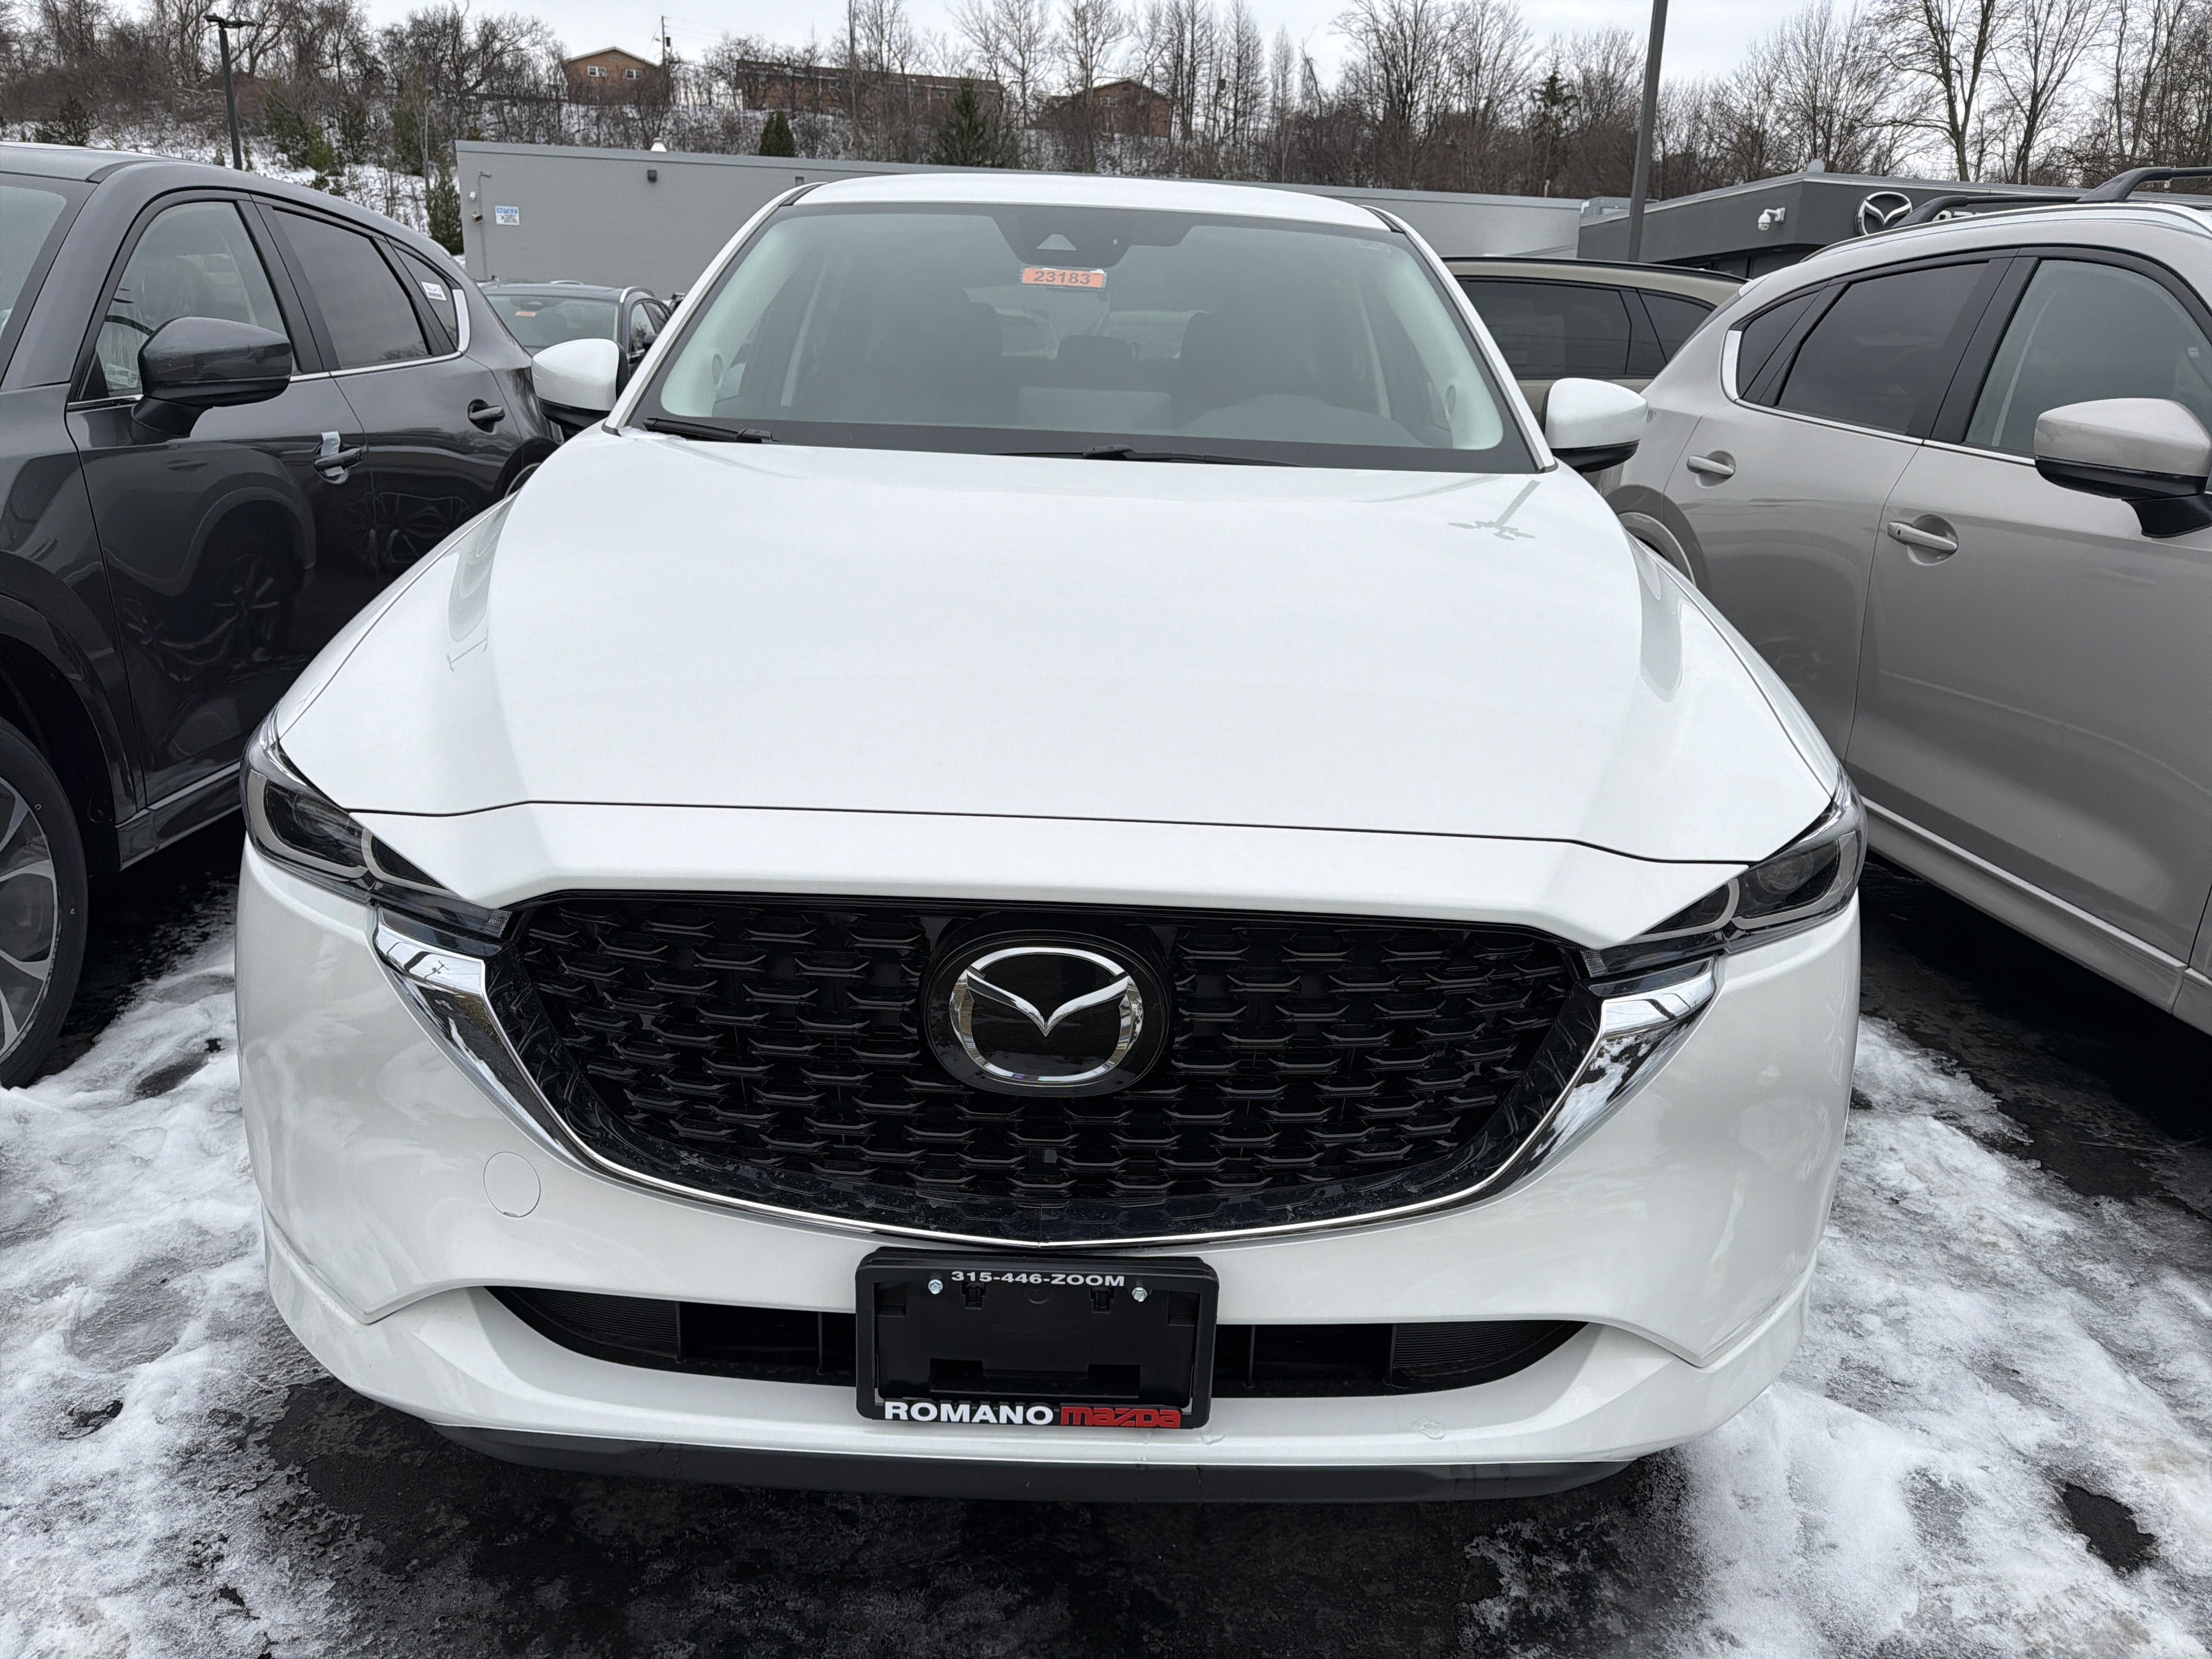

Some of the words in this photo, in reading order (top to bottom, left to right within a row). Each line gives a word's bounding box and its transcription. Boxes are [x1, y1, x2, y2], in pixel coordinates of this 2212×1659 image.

[1032, 271, 1091, 285] 23183
[951, 1271, 1125, 1286] 315-446-ZOOM
[884, 1401, 1053, 1426] ROMANO
